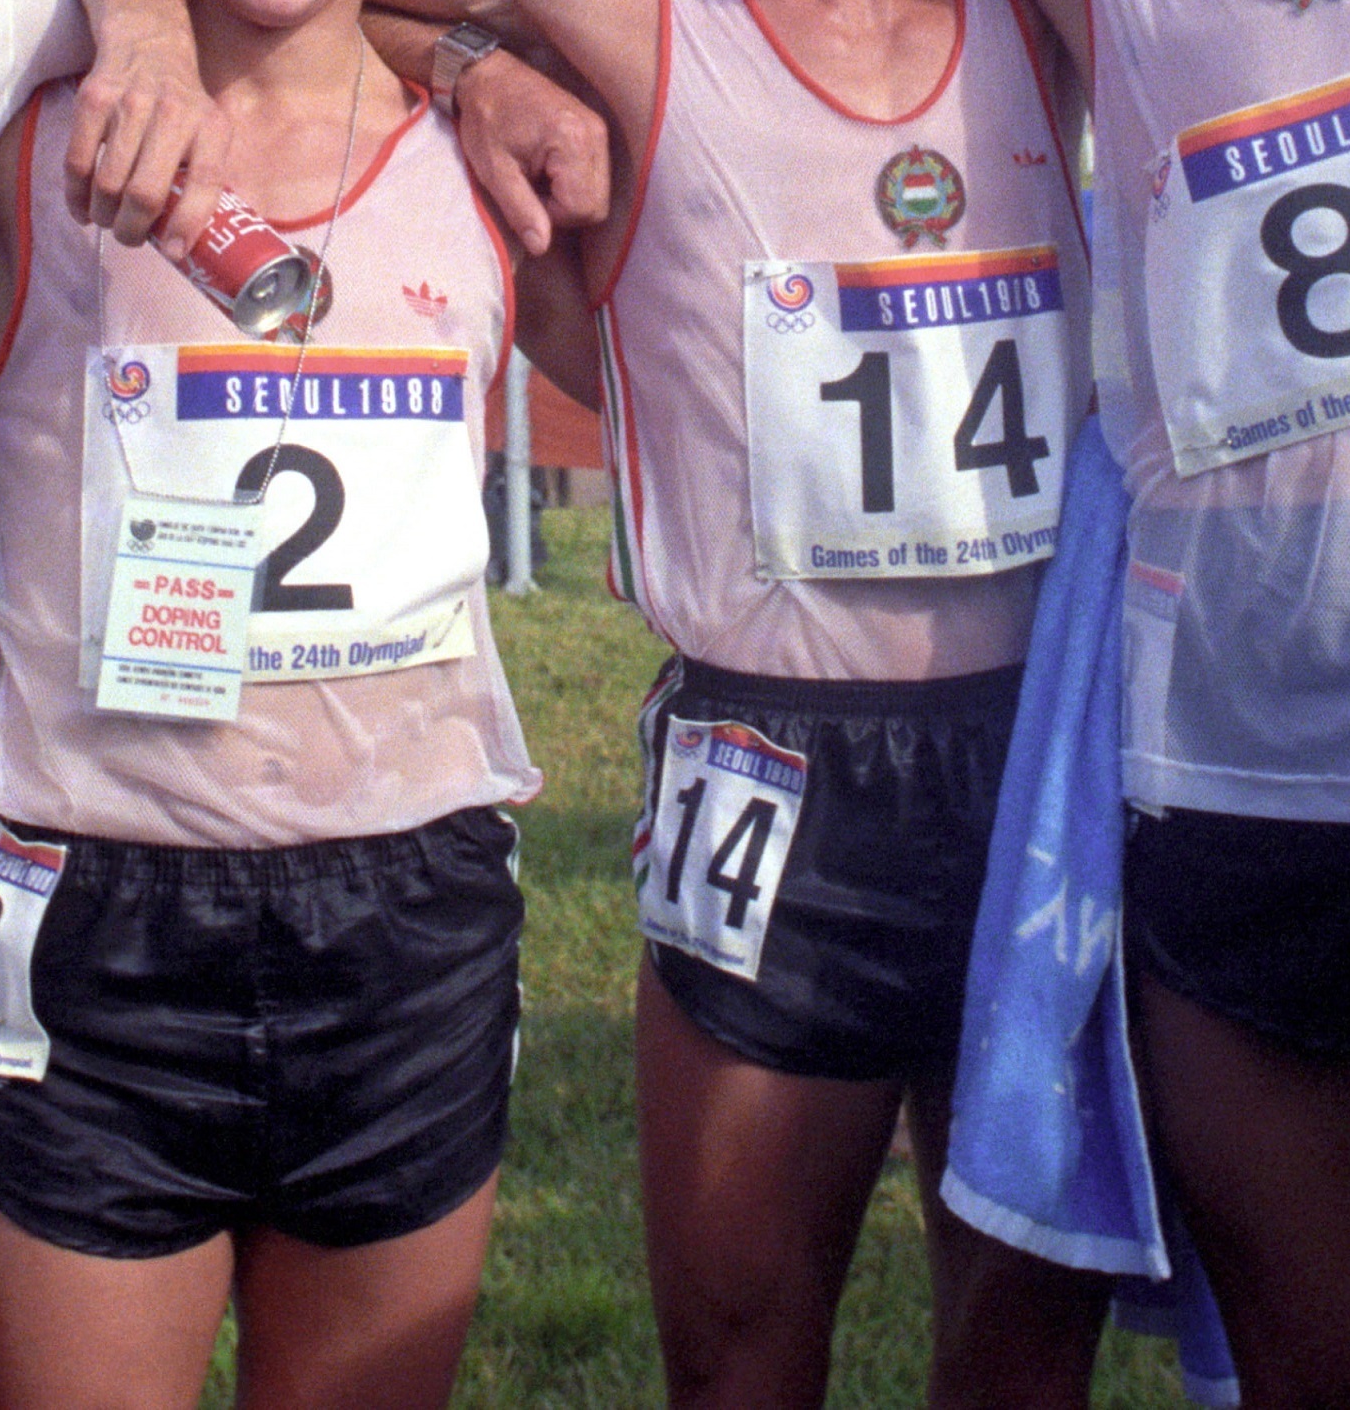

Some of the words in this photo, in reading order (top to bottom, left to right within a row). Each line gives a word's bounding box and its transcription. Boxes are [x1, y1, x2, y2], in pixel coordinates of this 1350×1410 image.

[820, 339, 1051, 514] 14
[1226, 412, 1292, 451] Games
[1296, 400, 1317, 428] of
[233, 443, 354, 613] 2
[811, 544, 880, 568] Games
[888, 542, 908, 566] of
[916, 542, 948, 565] the
[957, 537, 998, 564] 24th
[142, 604, 222, 630] DOPING
[128, 626, 228, 655] CONTROL
[249, 646, 283, 670] the
[291, 643, 341, 670] 24th
[349, 630, 427, 667] Olympiad
[666, 777, 778, 930] 14
